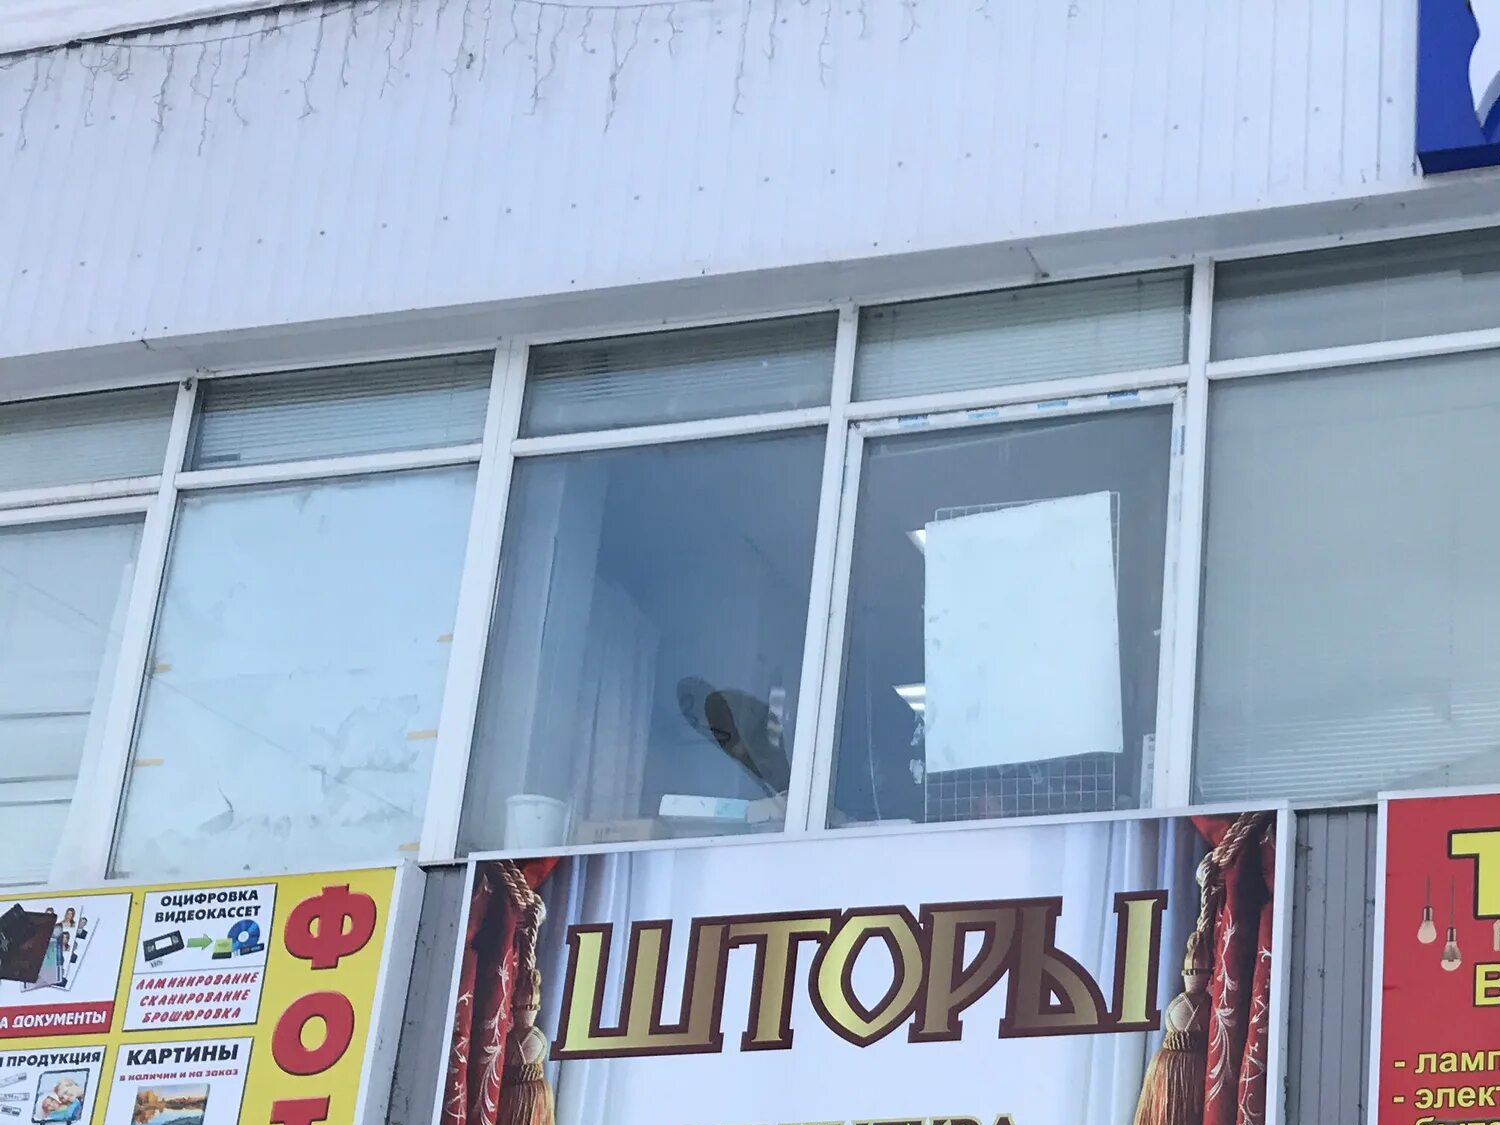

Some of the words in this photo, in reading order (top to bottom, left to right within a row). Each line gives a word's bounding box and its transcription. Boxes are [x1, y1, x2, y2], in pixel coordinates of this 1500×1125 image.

[160, 889, 259, 907] ОЦИФРОВКА
[155, 905, 261, 923] ВИДЕОКАССЕТ
[136, 972, 259, 991] ЛАМИНИРОВАНИЕ
[550, 889, 1168, 1060] ШТОРЫ
[140, 989, 250, 1006] СКАНИРОВАНИЕ
[12, 1011, 106, 1028] ДОКУМЕНТЫ
[142, 1007, 241, 1023] БРОШЮРОВКА
[7, 1052, 101, 1067] ПРОДУКЦИЯ
[126, 1044, 239, 1066] КАРТИНЫ
[128, 1071, 177, 1081] наличии
[189, 1070, 202, 1078] на
[205, 1067, 239, 1077] заказ
